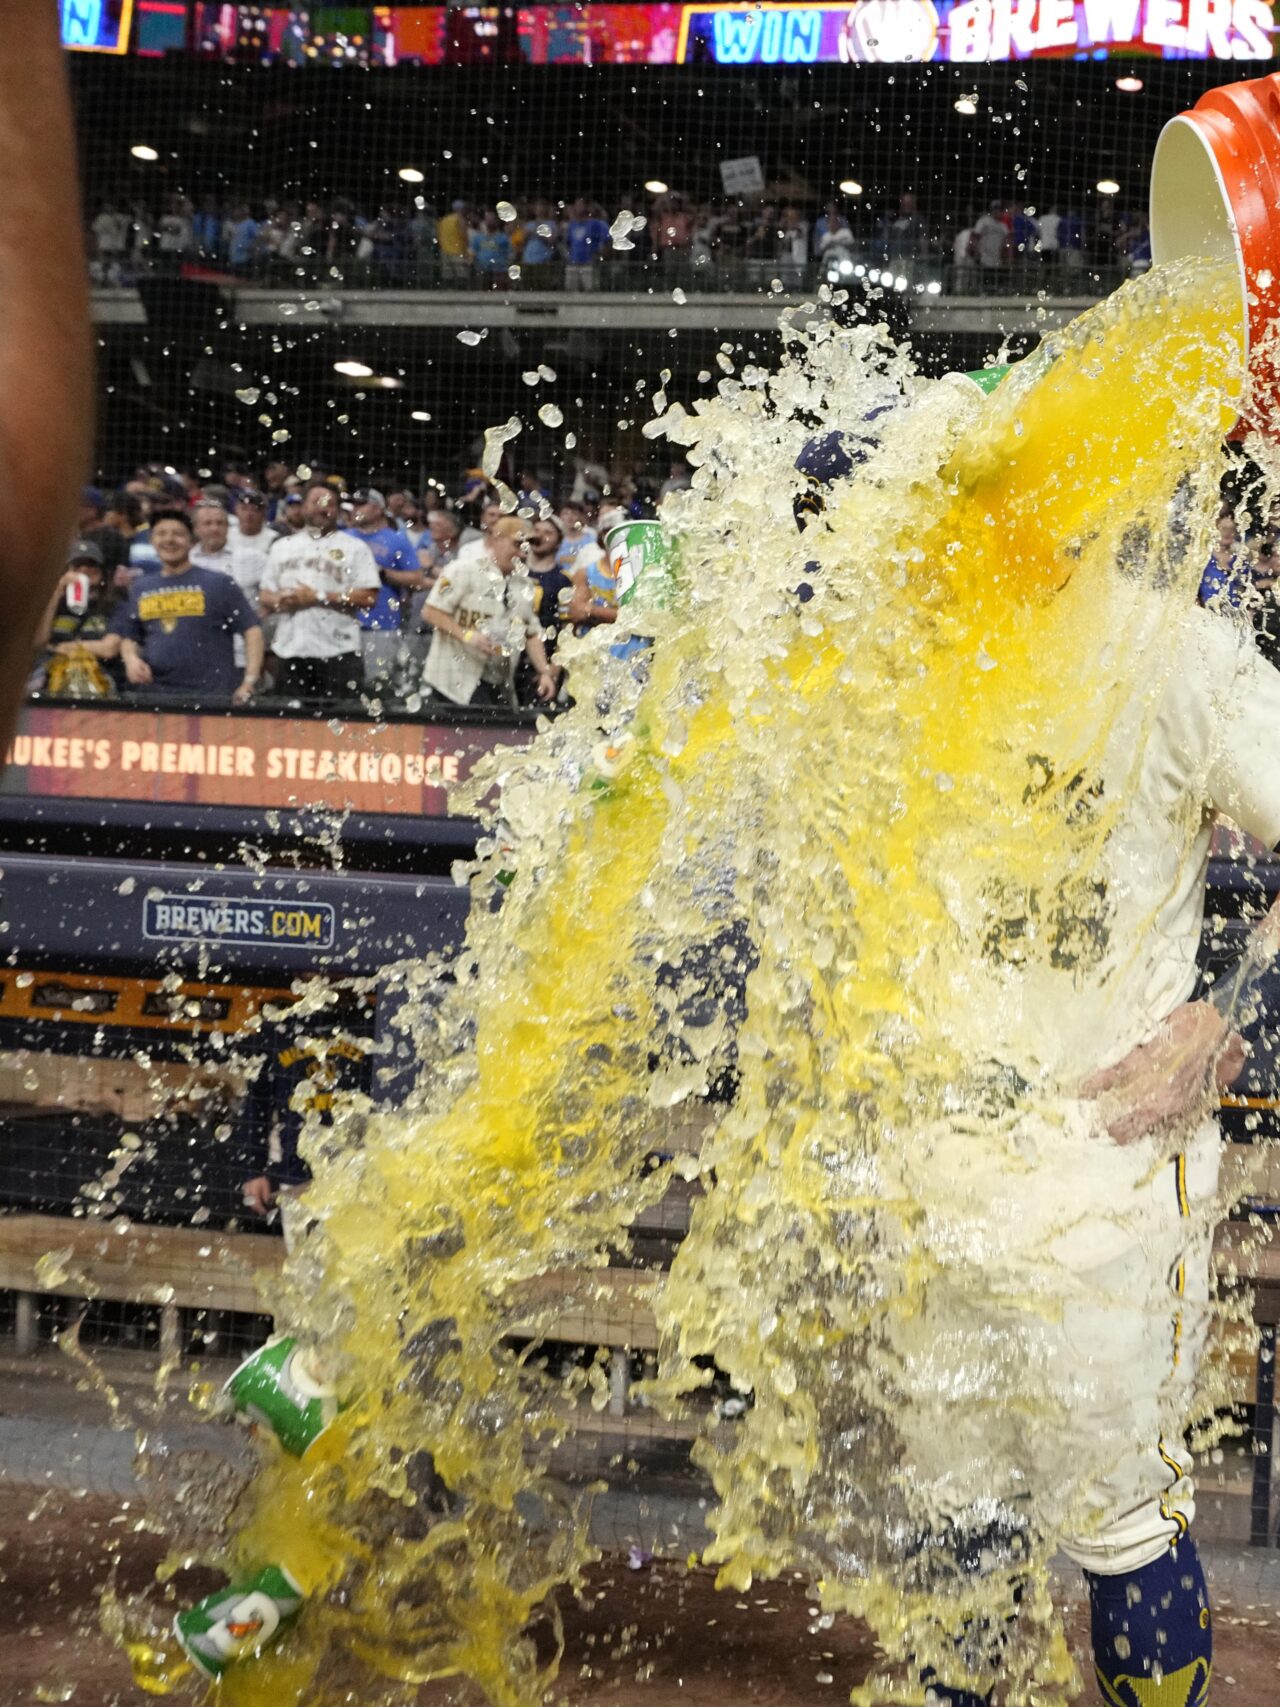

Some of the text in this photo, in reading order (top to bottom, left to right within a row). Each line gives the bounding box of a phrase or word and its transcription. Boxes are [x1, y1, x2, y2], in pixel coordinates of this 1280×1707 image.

[713, 10, 822, 63] WIN
[948, 0, 1275, 63] BREWERS
[5, 735, 459, 787] UKEE'S PREMIER STEAKHOUSE
